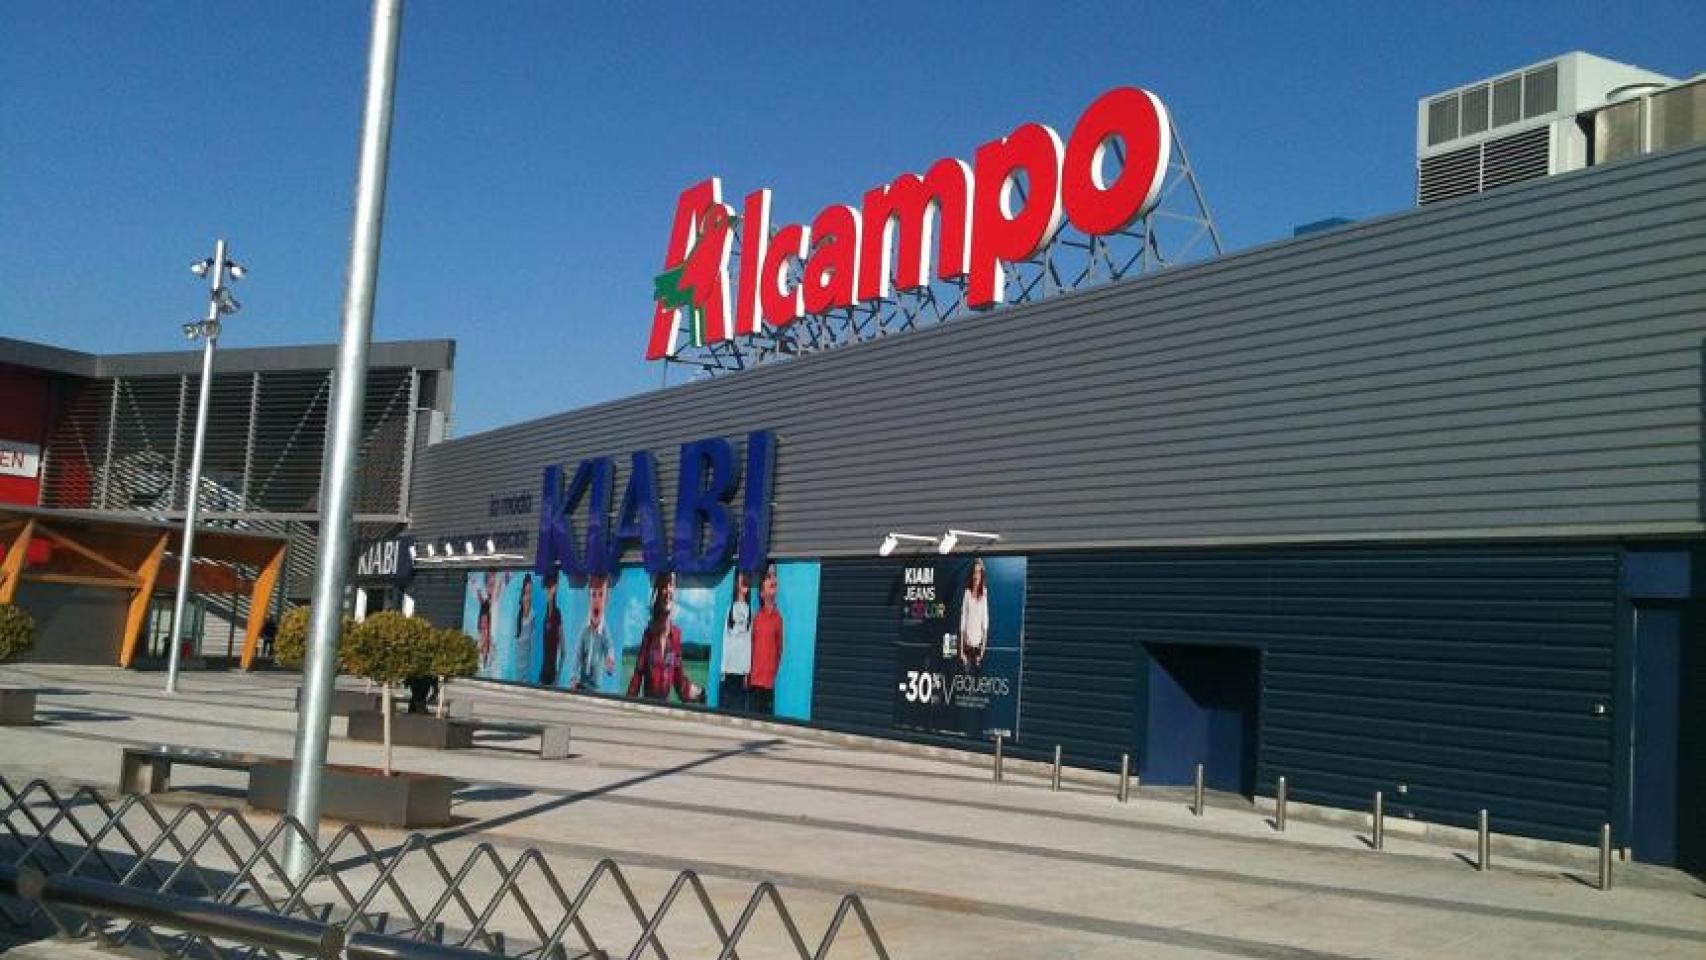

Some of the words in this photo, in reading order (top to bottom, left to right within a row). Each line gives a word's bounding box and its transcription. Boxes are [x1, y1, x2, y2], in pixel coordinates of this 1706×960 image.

[646, 86, 1171, 360] Alcampo
[536, 428, 779, 575] KIABI
[357, 540, 399, 576] KIABI
[905, 567, 934, 585] KIABI
[904, 586, 936, 601] JEANS
[942, 673, 1010, 705] Vaqueros
